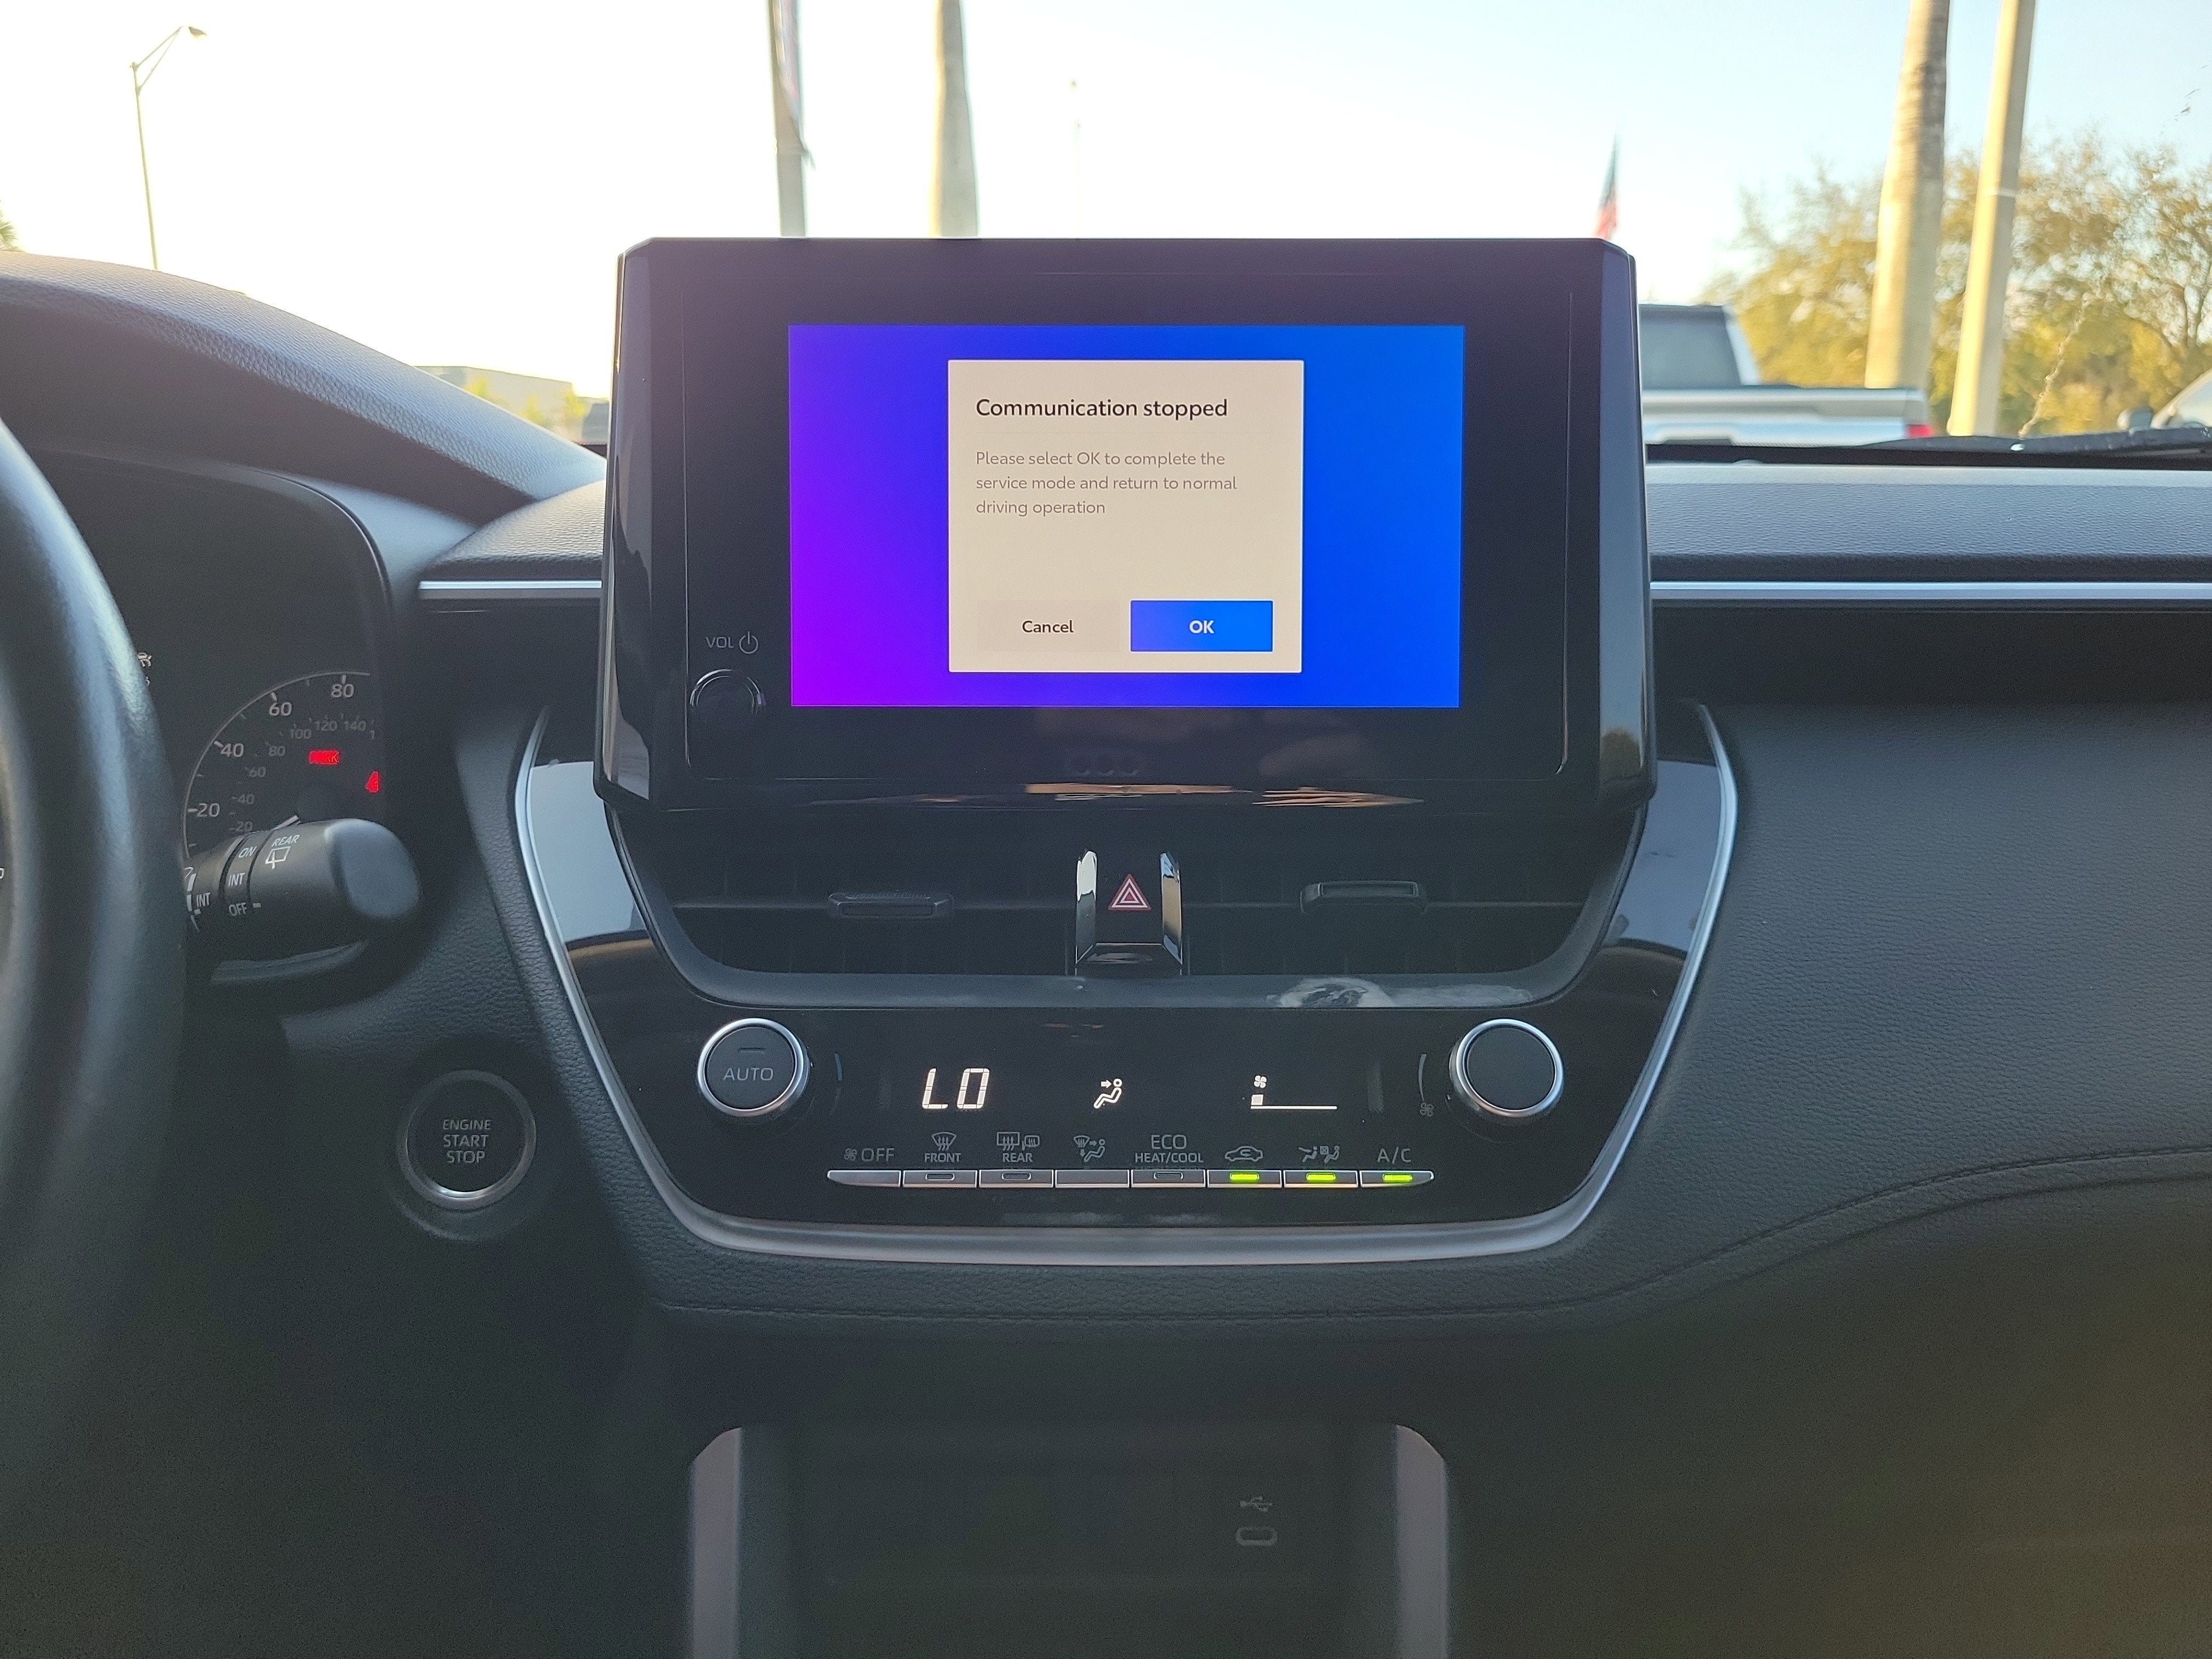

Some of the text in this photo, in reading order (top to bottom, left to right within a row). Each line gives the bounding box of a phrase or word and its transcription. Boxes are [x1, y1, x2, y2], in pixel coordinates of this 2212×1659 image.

[975, 398, 1228, 421] Communication stopped
[976, 451, 1226, 469] Please select OK to complete the
[975, 475, 1238, 489] service mode and return to normal
[975, 499, 1105, 517] driving operation
[1022, 619, 1215, 634] Cancel OK
[706, 636, 735, 649] VOL
[331, 684, 354, 698] 80
[268, 702, 292, 716] 60
[315, 720, 338, 731] 120
[290, 729, 312, 740] 100
[221, 743, 244, 758] 40
[196, 803, 220, 817] 20
[272, 834, 300, 847] REAR
[238, 845, 257, 859] ON
[228, 872, 246, 887] INT
[196, 892, 211, 907] INT
[228, 902, 247, 917] OFF
[723, 1067, 774, 1081] AUTO
[922, 1068, 990, 1109] LO
[442, 1119, 492, 1130] ENGINE
[443, 1134, 489, 1147] START
[1150, 1134, 1187, 1150] ECO
[447, 1150, 486, 1164] STOP
[861, 1148, 895, 1162] OFF
[924, 1153, 961, 1163] FRONT
[1002, 1153, 1033, 1163] REAR
[1135, 1152, 1204, 1164] HEAT/COOL
[1376, 1147, 1412, 1164] A/C
